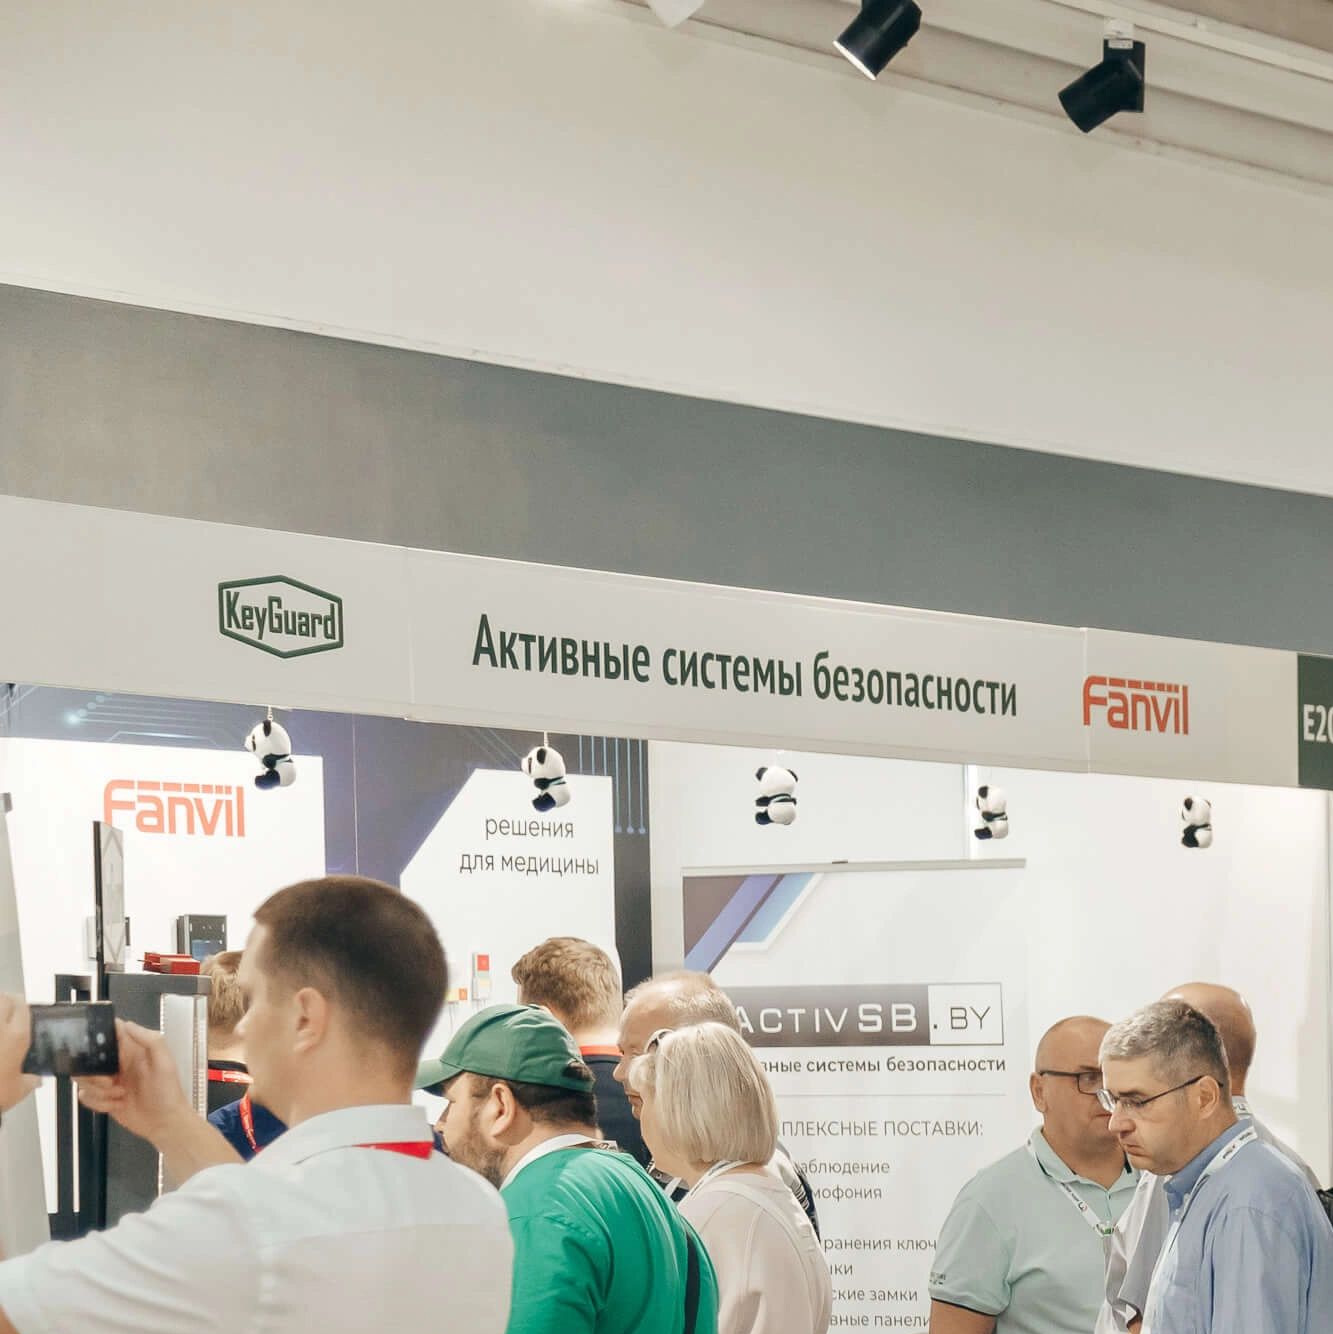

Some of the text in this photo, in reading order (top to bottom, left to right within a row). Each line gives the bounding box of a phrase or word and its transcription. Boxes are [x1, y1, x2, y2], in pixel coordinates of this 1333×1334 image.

[225, 590, 338, 640] KeyGuard
[472, 614, 1017, 717] Активные системы безопасности
[1082, 675, 1189, 735] Fanvil
[103, 780, 245, 838] Fanvil
[485, 816, 575, 843] решения
[460, 850, 600, 877] для медицины
[806, 1059, 881, 1073] системы
[886, 1057, 1006, 1073] безопасности
[781, 1119, 984, 1137] ПЛЕКСНЫЕ ПОСТАВКИ:
[801, 1159, 890, 1175] аблюдение
[813, 1185, 882, 1202] мофония
[824, 1238, 937, 1253] ранения ключ
[869, 1289, 918, 1301] замки
